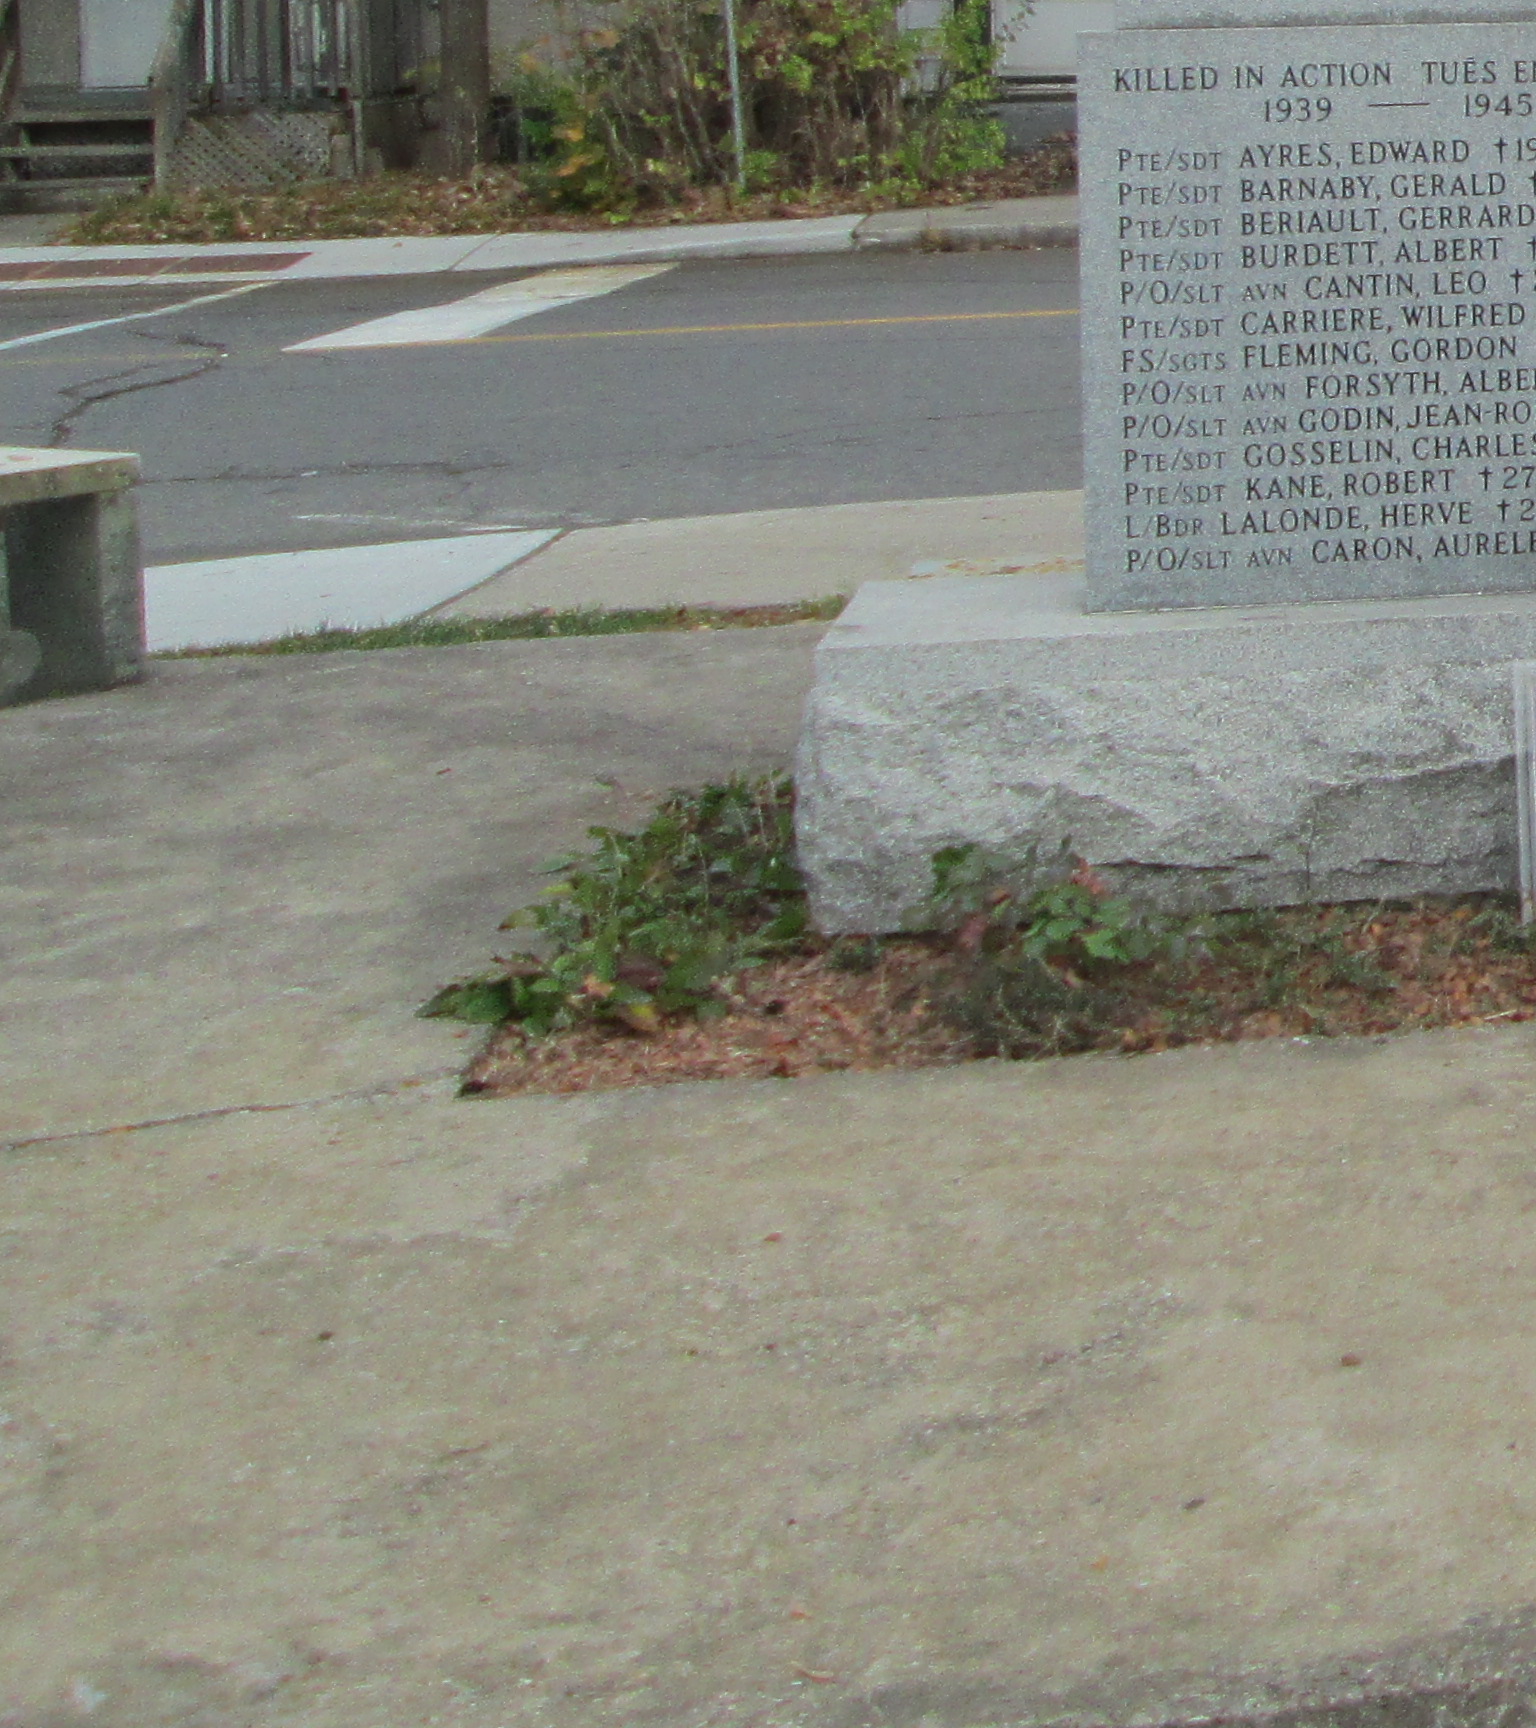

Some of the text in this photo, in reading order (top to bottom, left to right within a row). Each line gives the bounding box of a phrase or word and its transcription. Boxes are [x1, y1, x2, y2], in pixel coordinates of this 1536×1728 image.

[1113, 66, 1218, 92] KILLED
[1235, 65, 1264, 88] IN
[1280, 63, 1392, 88] ACTION
[1421, 59, 1497, 86] TUÉS
[1264, 93, 1533, 123] 1939 1945
[1240, 140, 1470, 169] AYRES, EDWARD
[1240, 174, 1507, 202] BARNABY, GERALD
[1240, 204, 1535, 236] BERIAULT, GERRARD
[1395, 238, 1503, 263] ALBERT
[1305, 272, 1487, 300] CANTIN, LEO
[1240, 304, 1526, 335] CARRIERE, WILFRED
[1244, 337, 1518, 368] FLEMING, GORDON
[1306, 373, 1447, 400] FORSYTH,
[1299, 407, 1400, 432] GODIN,
[1244, 440, 1400, 468] GOSSELIN,
[1245, 470, 1456, 502] KANE, ROBERT
[1221, 502, 1472, 534] LALONDE, HERVE
[1312, 537, 1422, 564] CARON,
